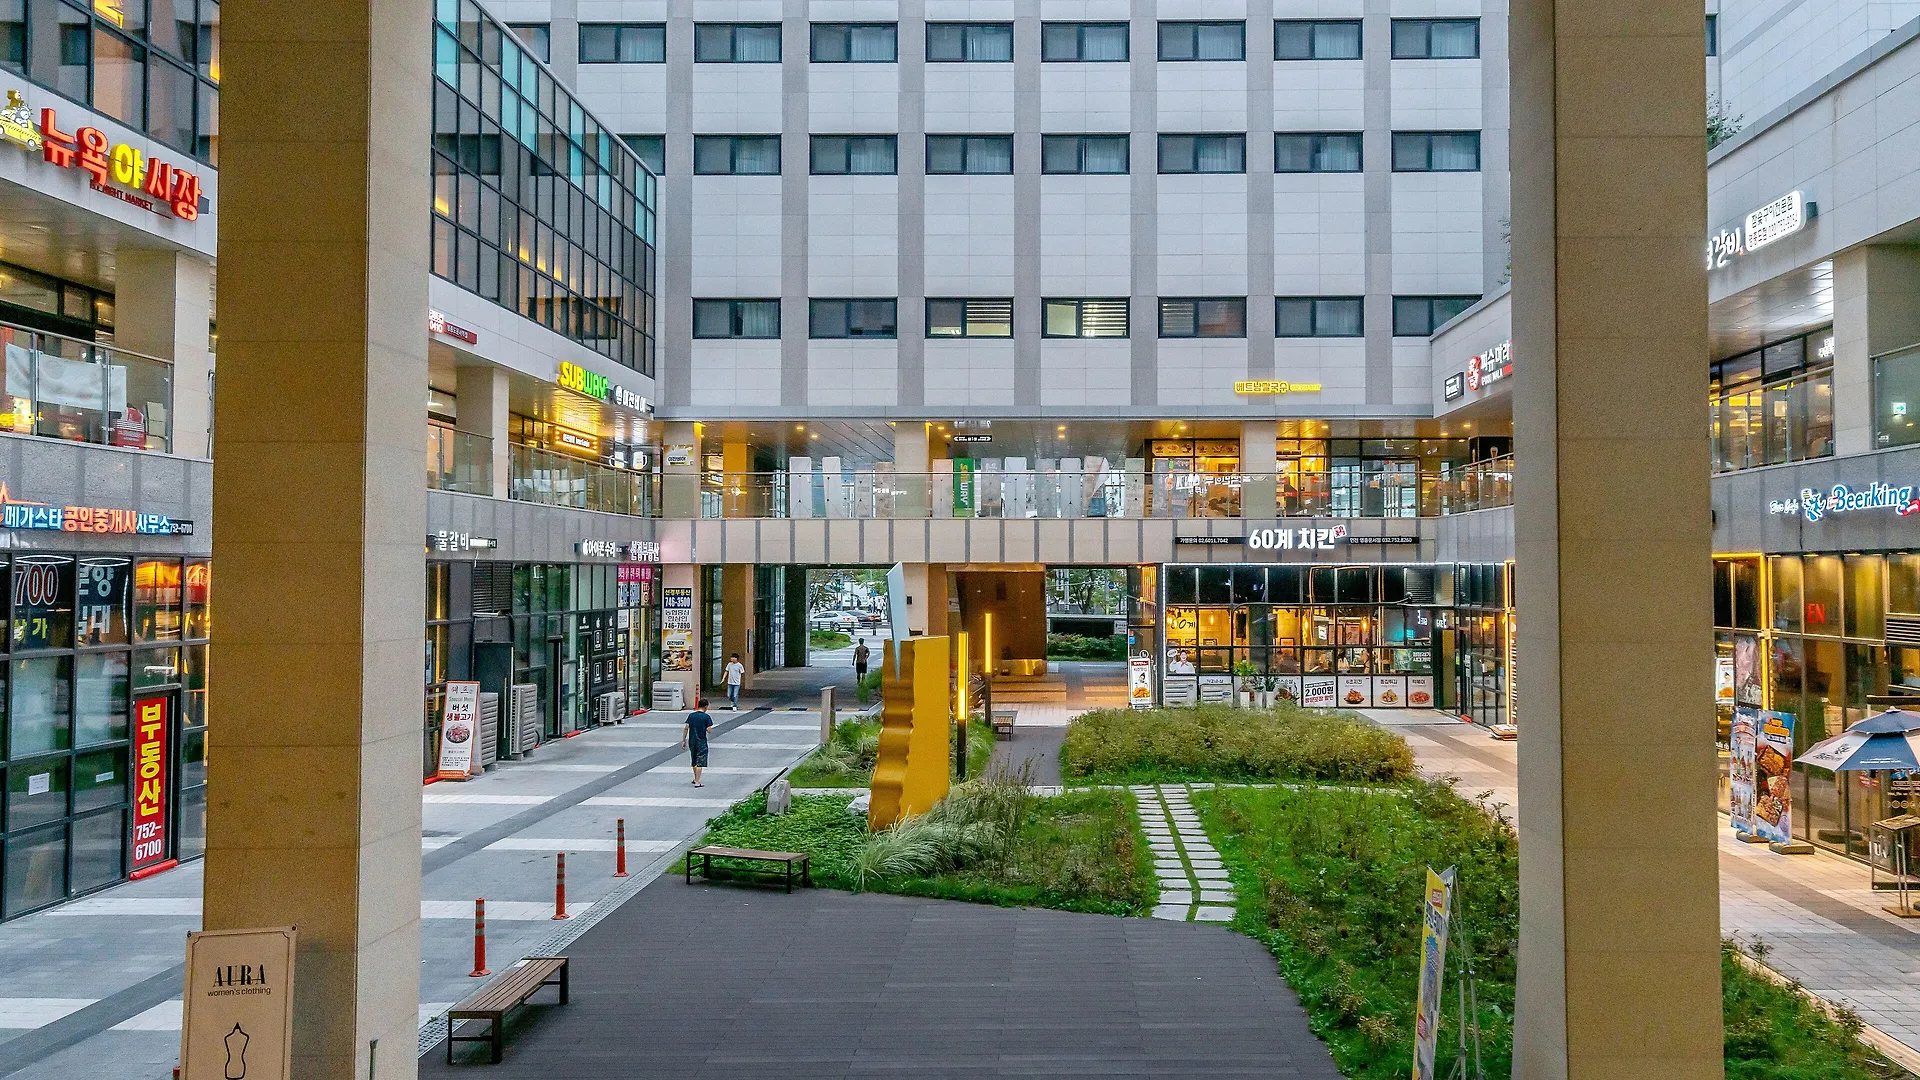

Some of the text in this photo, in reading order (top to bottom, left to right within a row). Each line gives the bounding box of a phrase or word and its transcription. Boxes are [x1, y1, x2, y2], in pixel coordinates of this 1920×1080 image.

[559, 361, 608, 399] SUBWAY
[1833, 482, 1912, 515] Beerking
[438, 530, 469, 551] 물갈비
[1249, 527, 1335, 550] 60계 치킨
[452, 704, 469, 712] 버섯
[138, 703, 161, 817] 부동산
[136, 821, 162, 841] 752-
[135, 839, 162, 861] 6700
[213, 964, 266, 988] AURA
[207, 986, 271, 997] women's clothing
